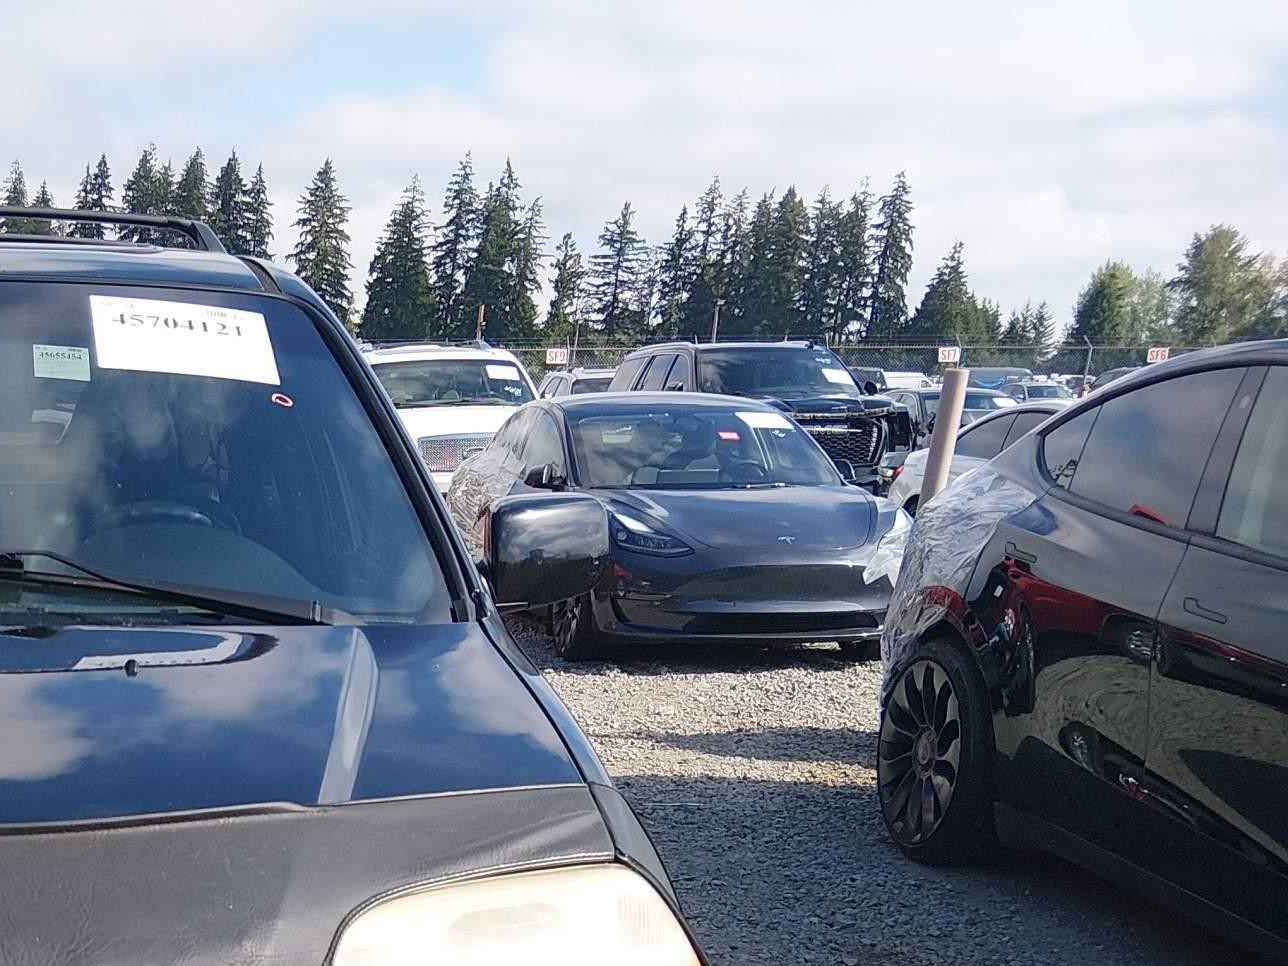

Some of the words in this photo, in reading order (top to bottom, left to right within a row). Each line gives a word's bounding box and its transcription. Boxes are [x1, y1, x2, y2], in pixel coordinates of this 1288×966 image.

[112, 313, 243, 336] 45704121
[548, 350, 566, 362] SF9
[941, 349, 957, 361] SF7
[1149, 350, 1166, 361] SF6
